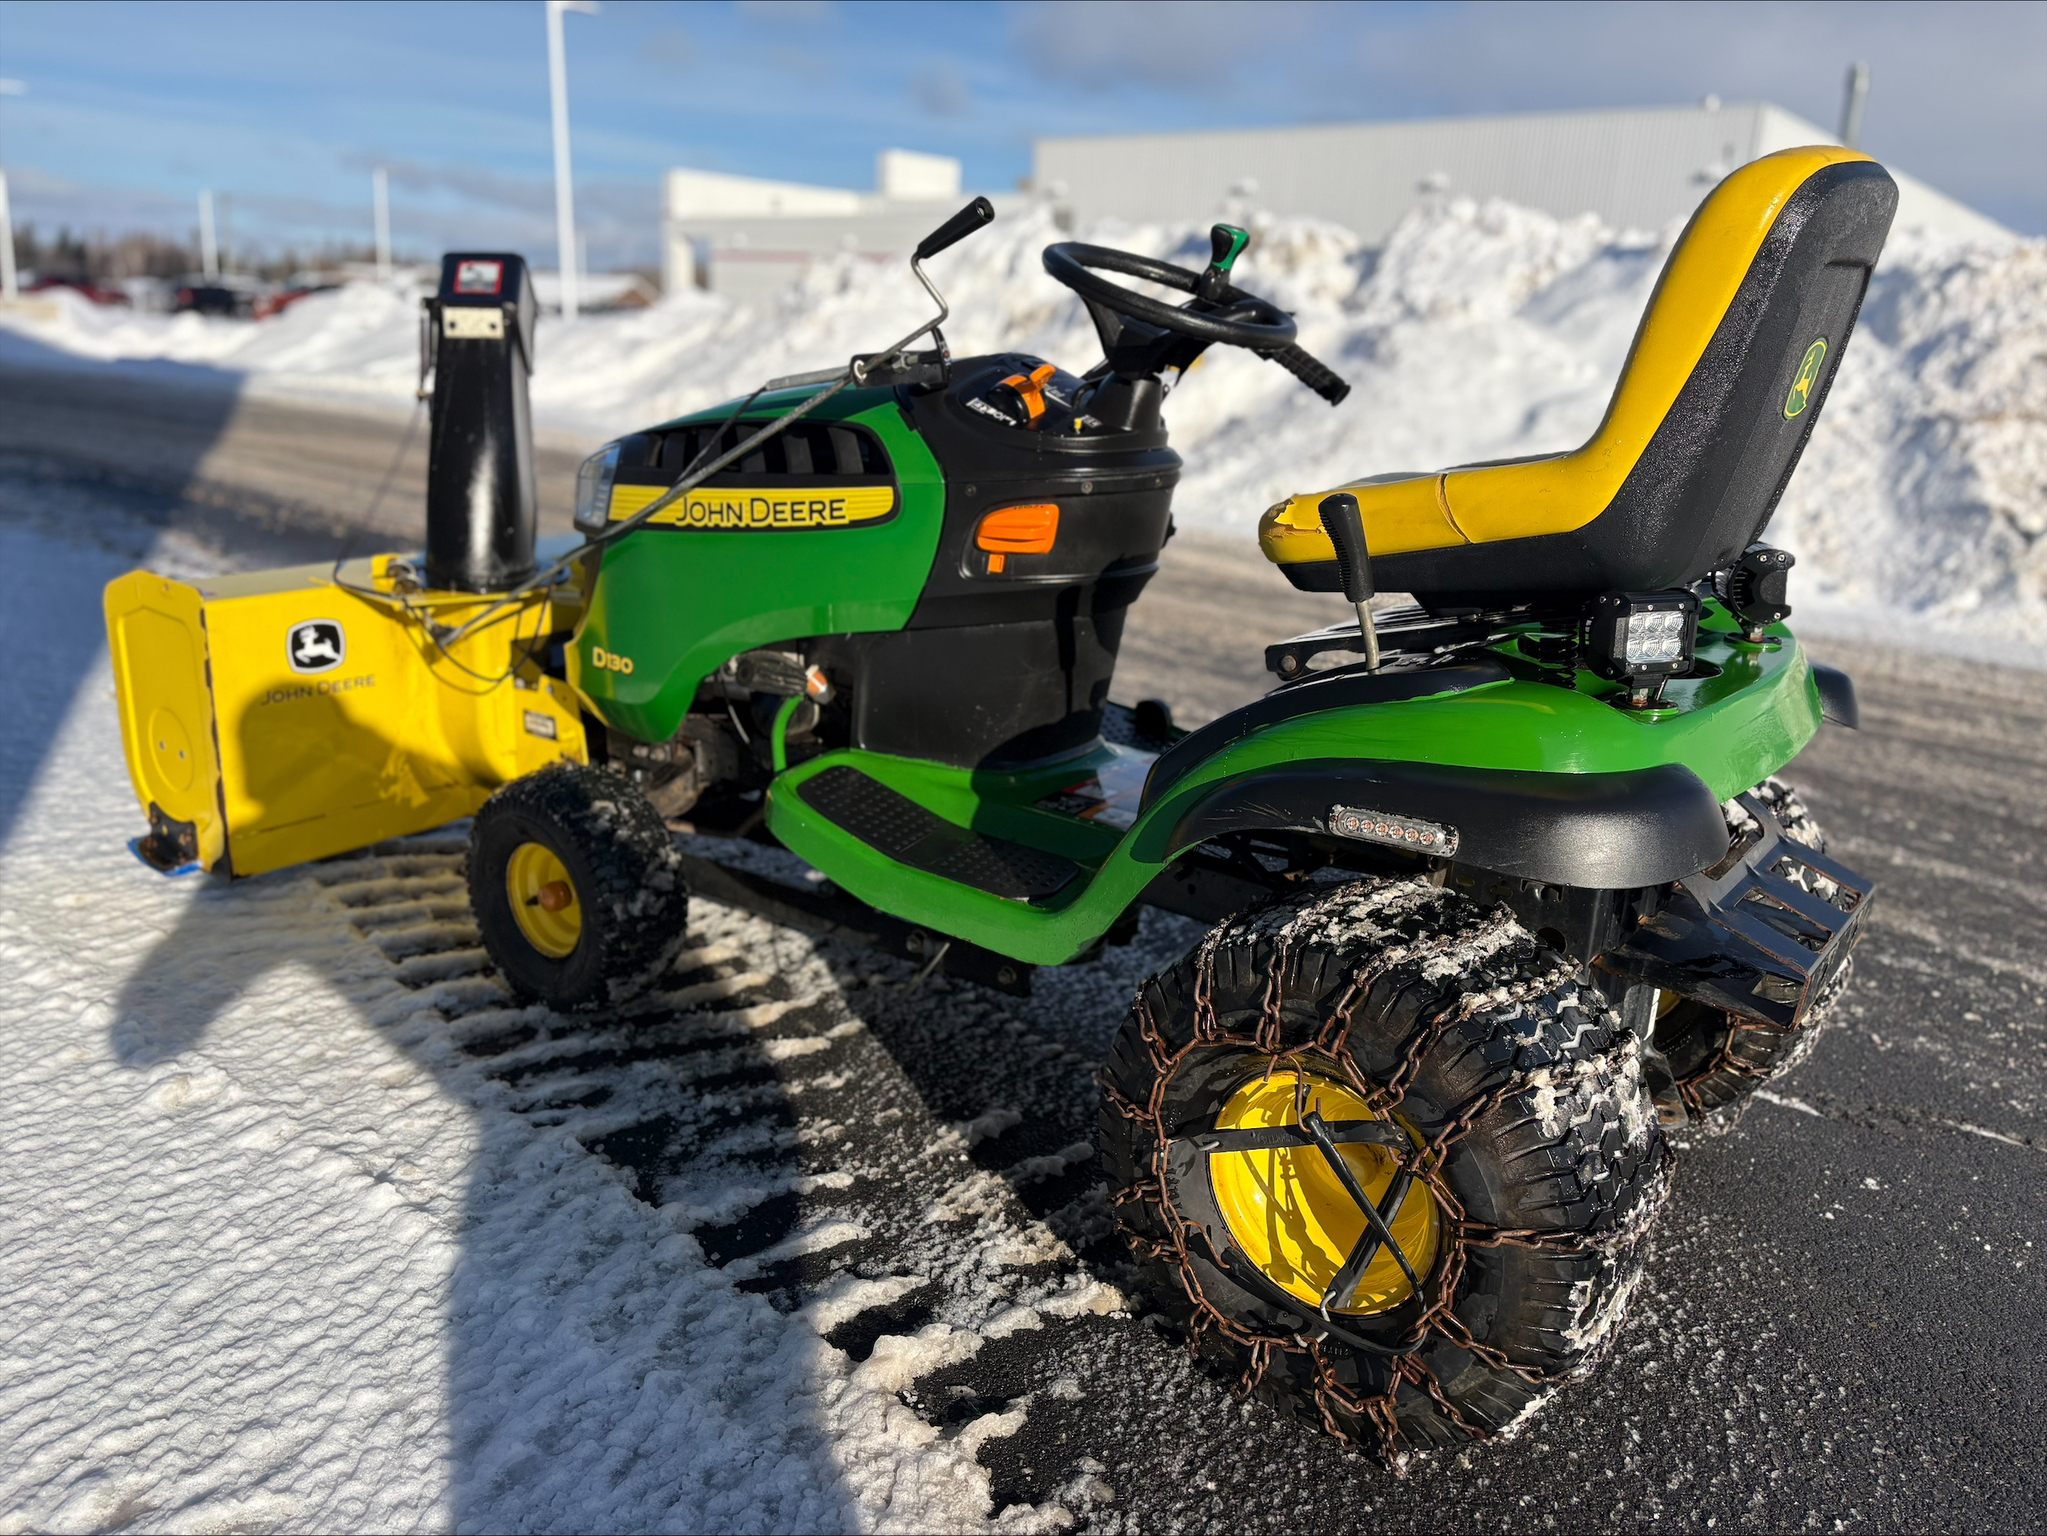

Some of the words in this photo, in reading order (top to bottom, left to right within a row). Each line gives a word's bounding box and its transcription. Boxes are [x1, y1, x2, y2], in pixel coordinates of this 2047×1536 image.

[676, 496, 744, 523] JOHN
[750, 497, 846, 523] DEERE
[592, 645, 634, 676] D130
[261, 685, 314, 707] JOHN
[317, 674, 376, 696] DEERE
